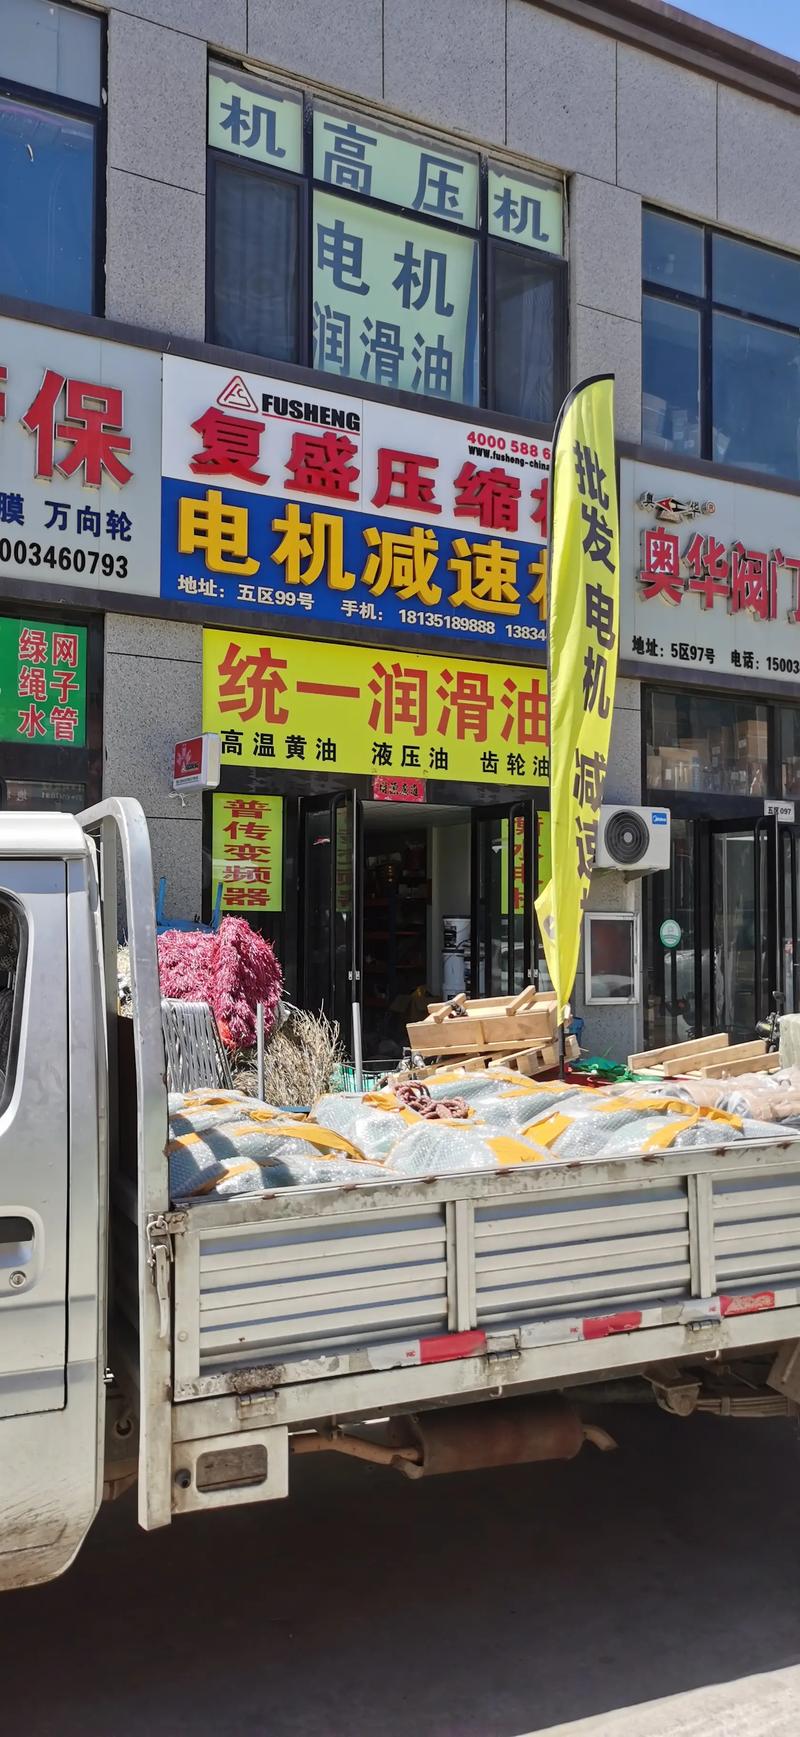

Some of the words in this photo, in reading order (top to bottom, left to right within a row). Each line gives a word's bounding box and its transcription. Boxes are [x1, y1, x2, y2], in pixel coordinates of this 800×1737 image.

[219, 96, 286, 159] 机
[493, 187, 550, 243] 机
[317, 220, 455, 317] 电机
[313, 301, 453, 397] 润滑油
[0, 366, 134, 489] 保
[262, 393, 361, 432] FUSHENG
[467, 431, 506, 451] 4000
[511, 440, 538, 458] 588
[44, 501, 133, 542] 万向轮
[572, 440, 616, 575] 批发
[237, 584, 315, 611] 五区99号
[398, 609, 496, 635] 18135189888
[19, 628, 79, 667] 绿网
[583, 582, 616, 720] 电机
[671, 643, 715, 664] 5区97号
[18, 665, 79, 703] 绳子
[217, 642, 549, 748] 统一润滑油
[17, 703, 78, 741] 水管
[220, 728, 338, 762] 高温黄油
[371, 741, 449, 771] 液压油
[480, 750, 549, 778] 齿轮油
[223, 799, 272, 906] 普传变频器
